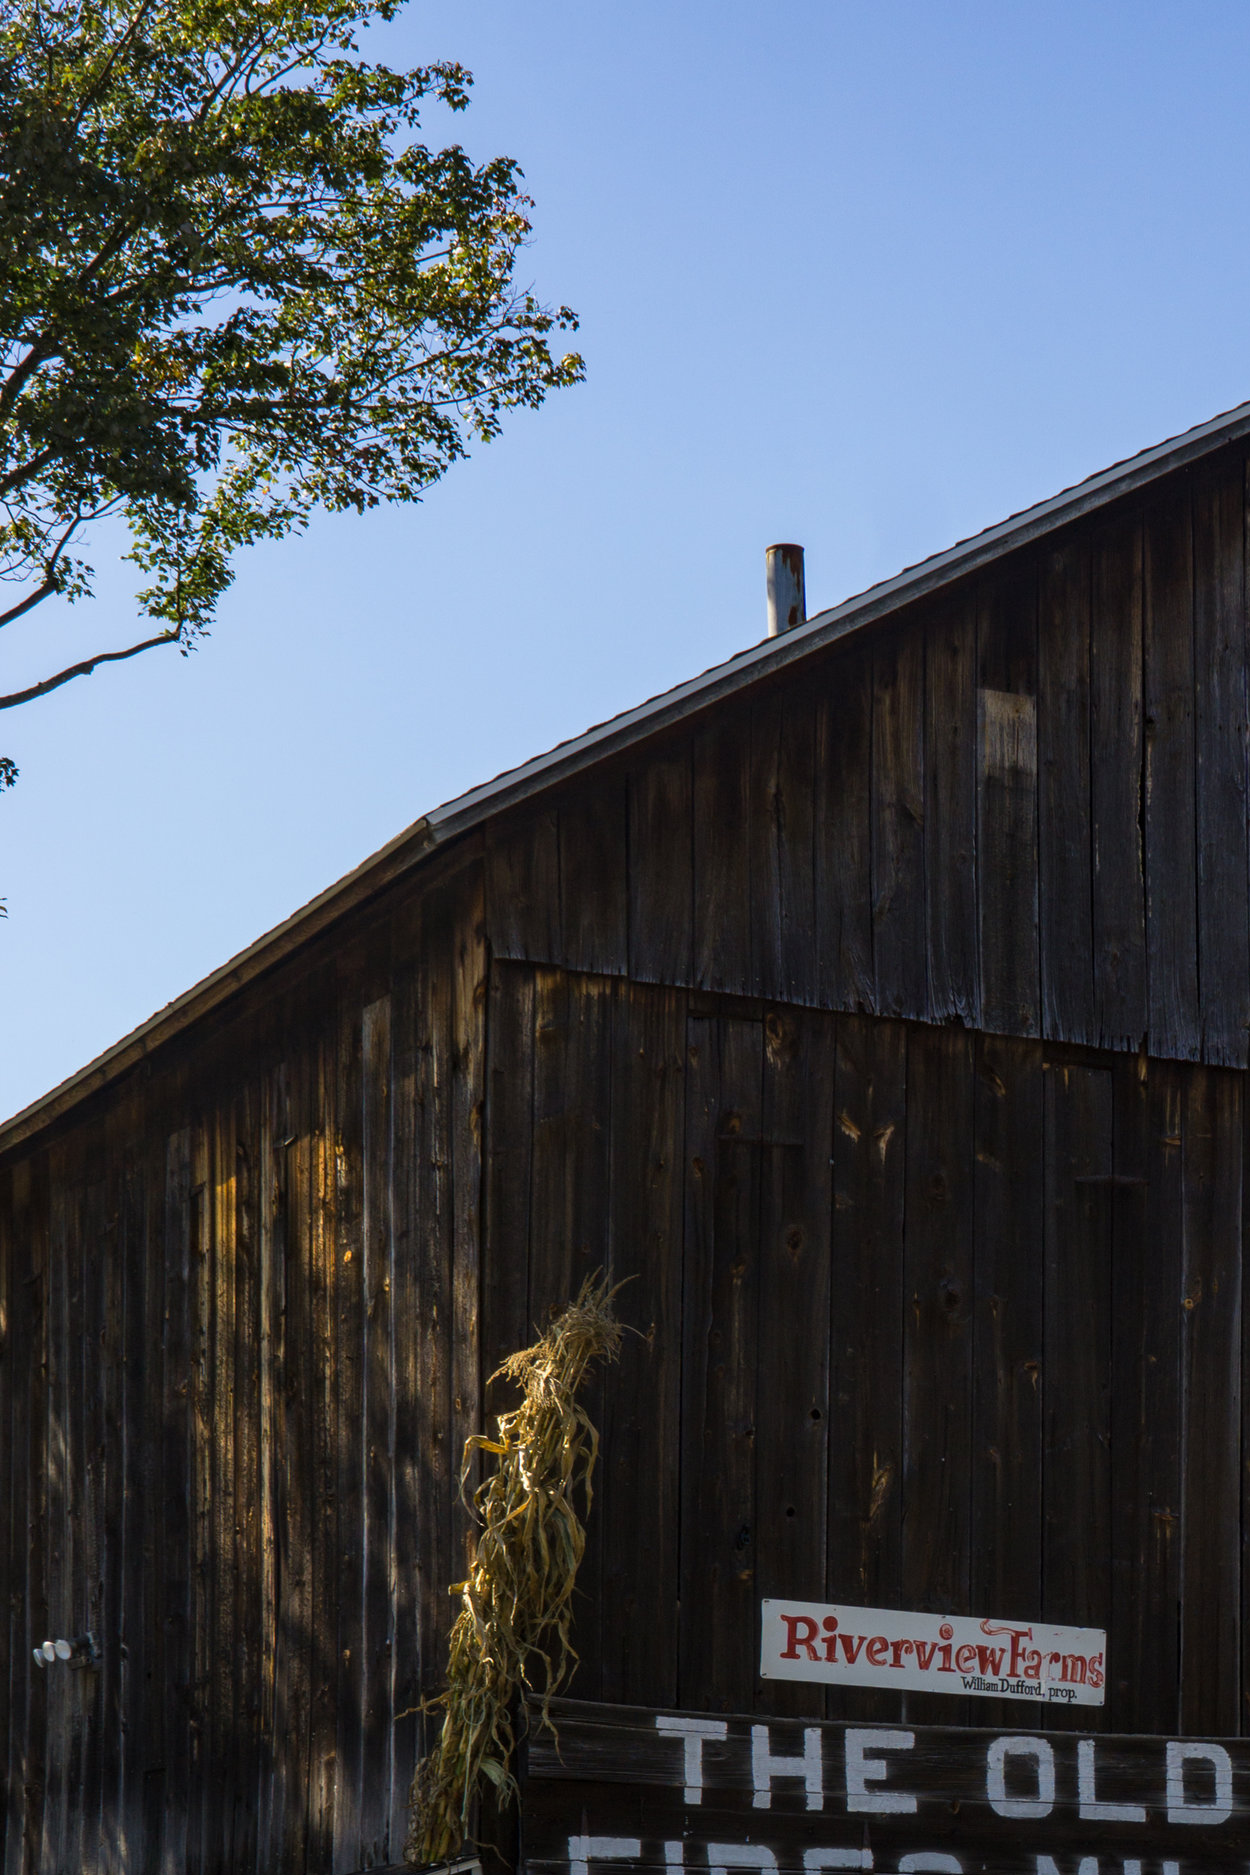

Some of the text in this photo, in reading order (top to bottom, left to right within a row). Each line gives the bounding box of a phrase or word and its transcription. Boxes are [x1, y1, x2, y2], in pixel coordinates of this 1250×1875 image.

[779, 1614, 1105, 1689] Riverview Farms
[960, 1676, 1078, 1702] William Dufford, prop.
[655, 1715, 1233, 1825] THE OLD
